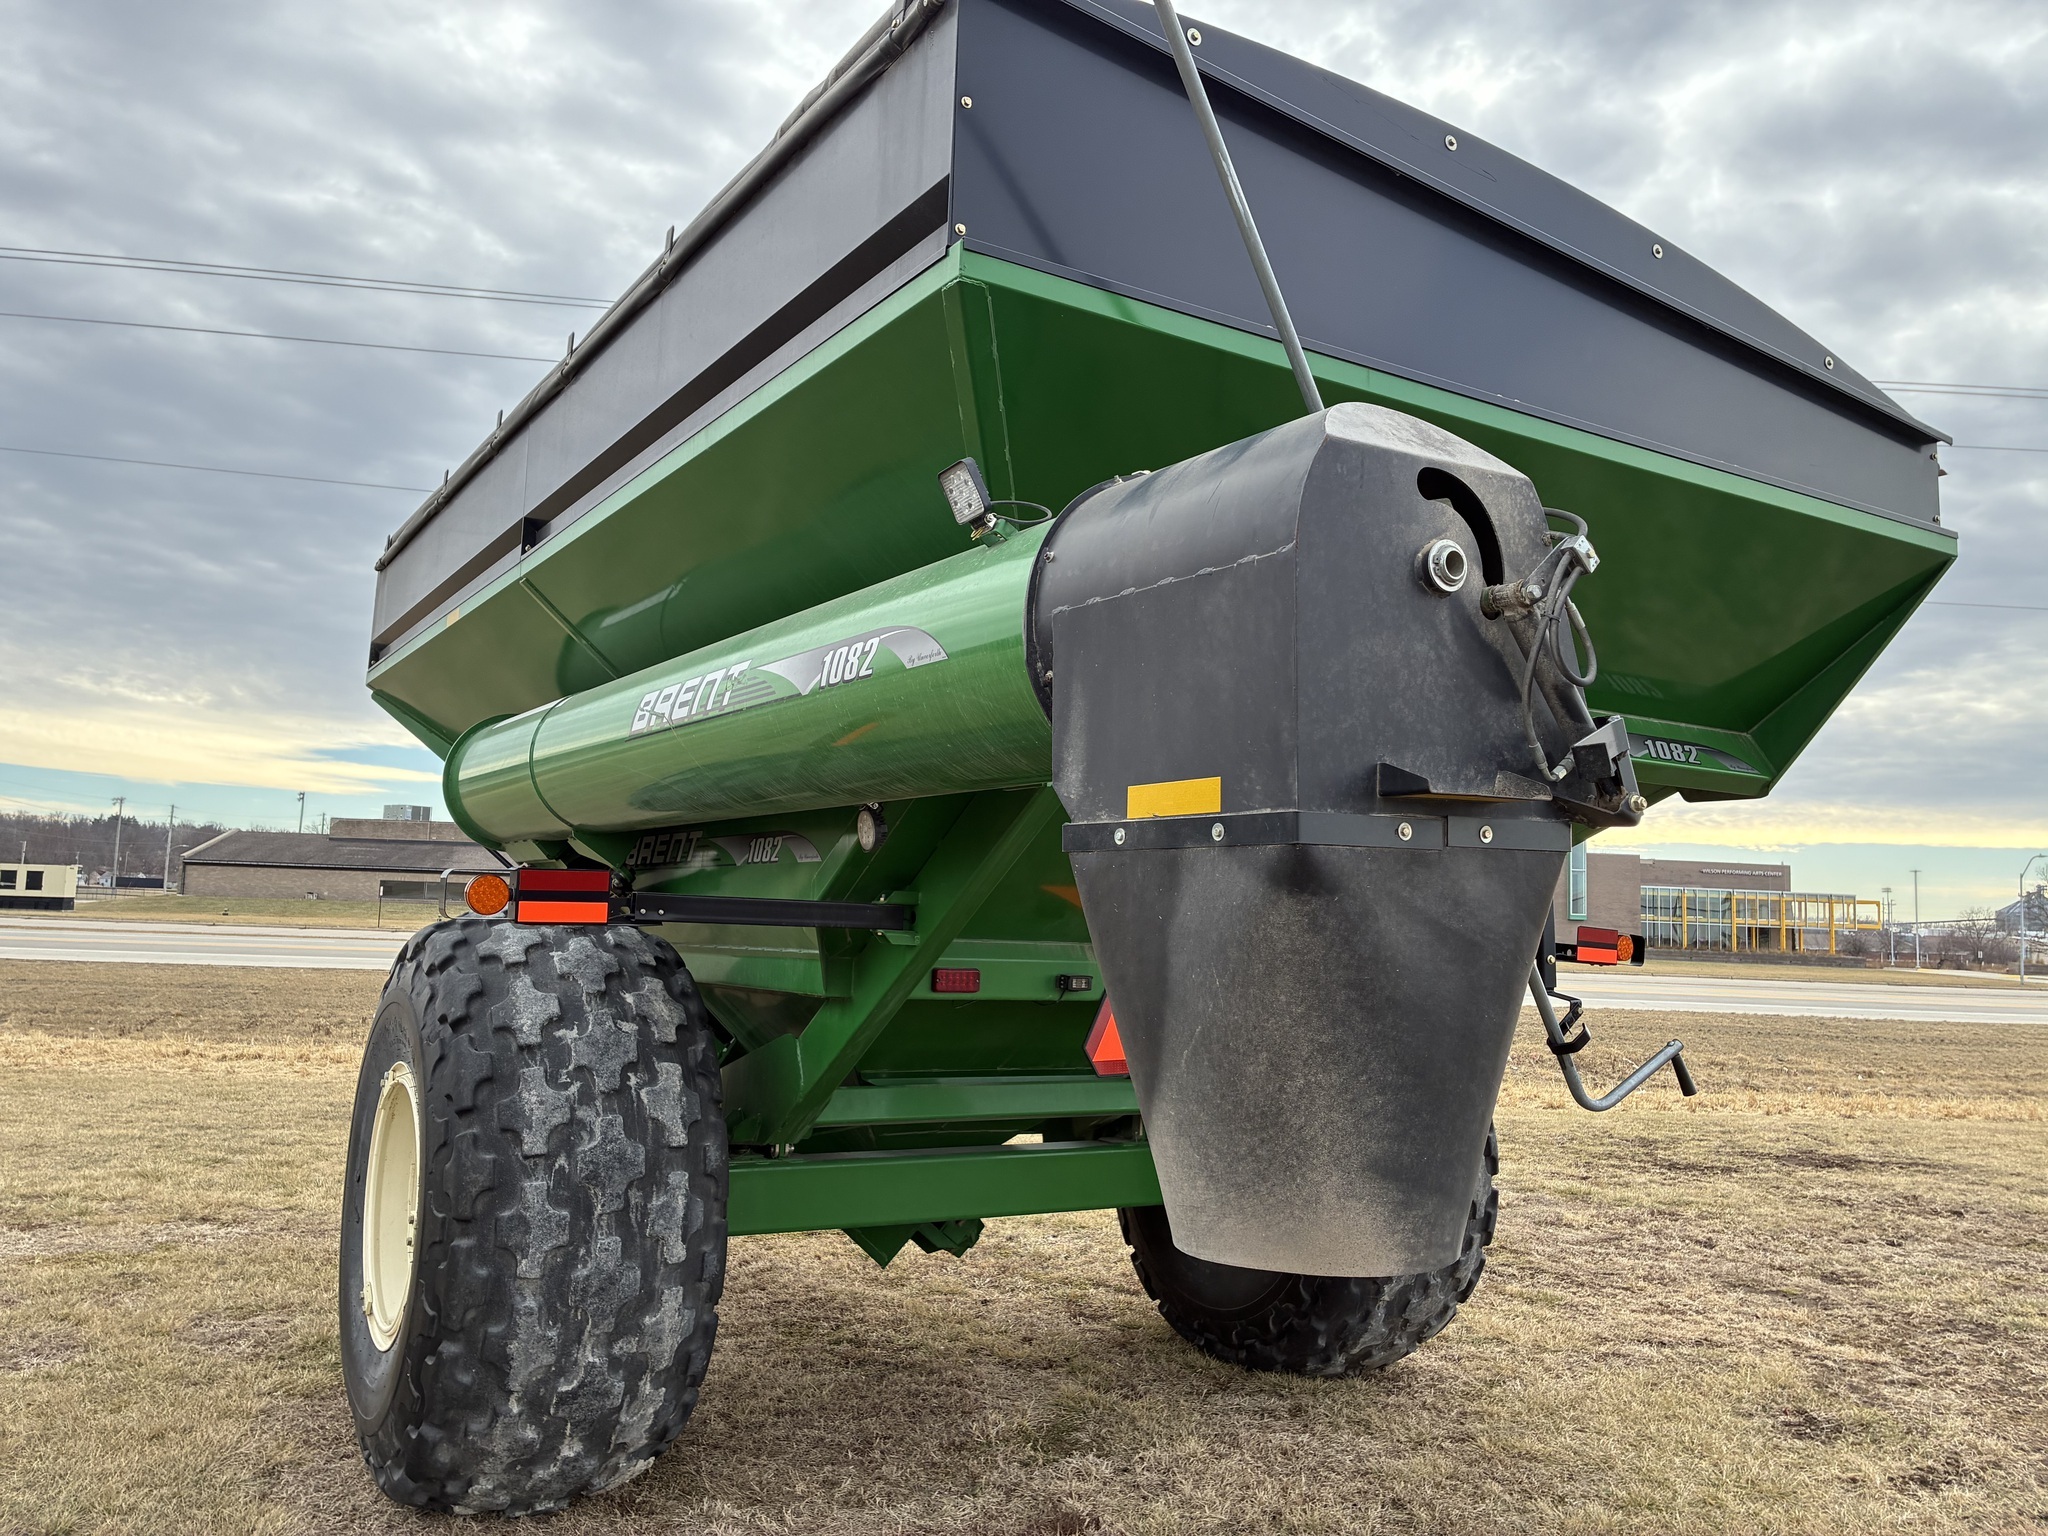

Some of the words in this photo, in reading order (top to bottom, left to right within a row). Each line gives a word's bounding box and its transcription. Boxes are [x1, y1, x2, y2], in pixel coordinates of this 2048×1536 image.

[631, 660, 752, 732] BRENT
[820, 637, 880, 687] 1082
[1645, 739, 1701, 764] 1082
[748, 837, 782, 863] 1082
